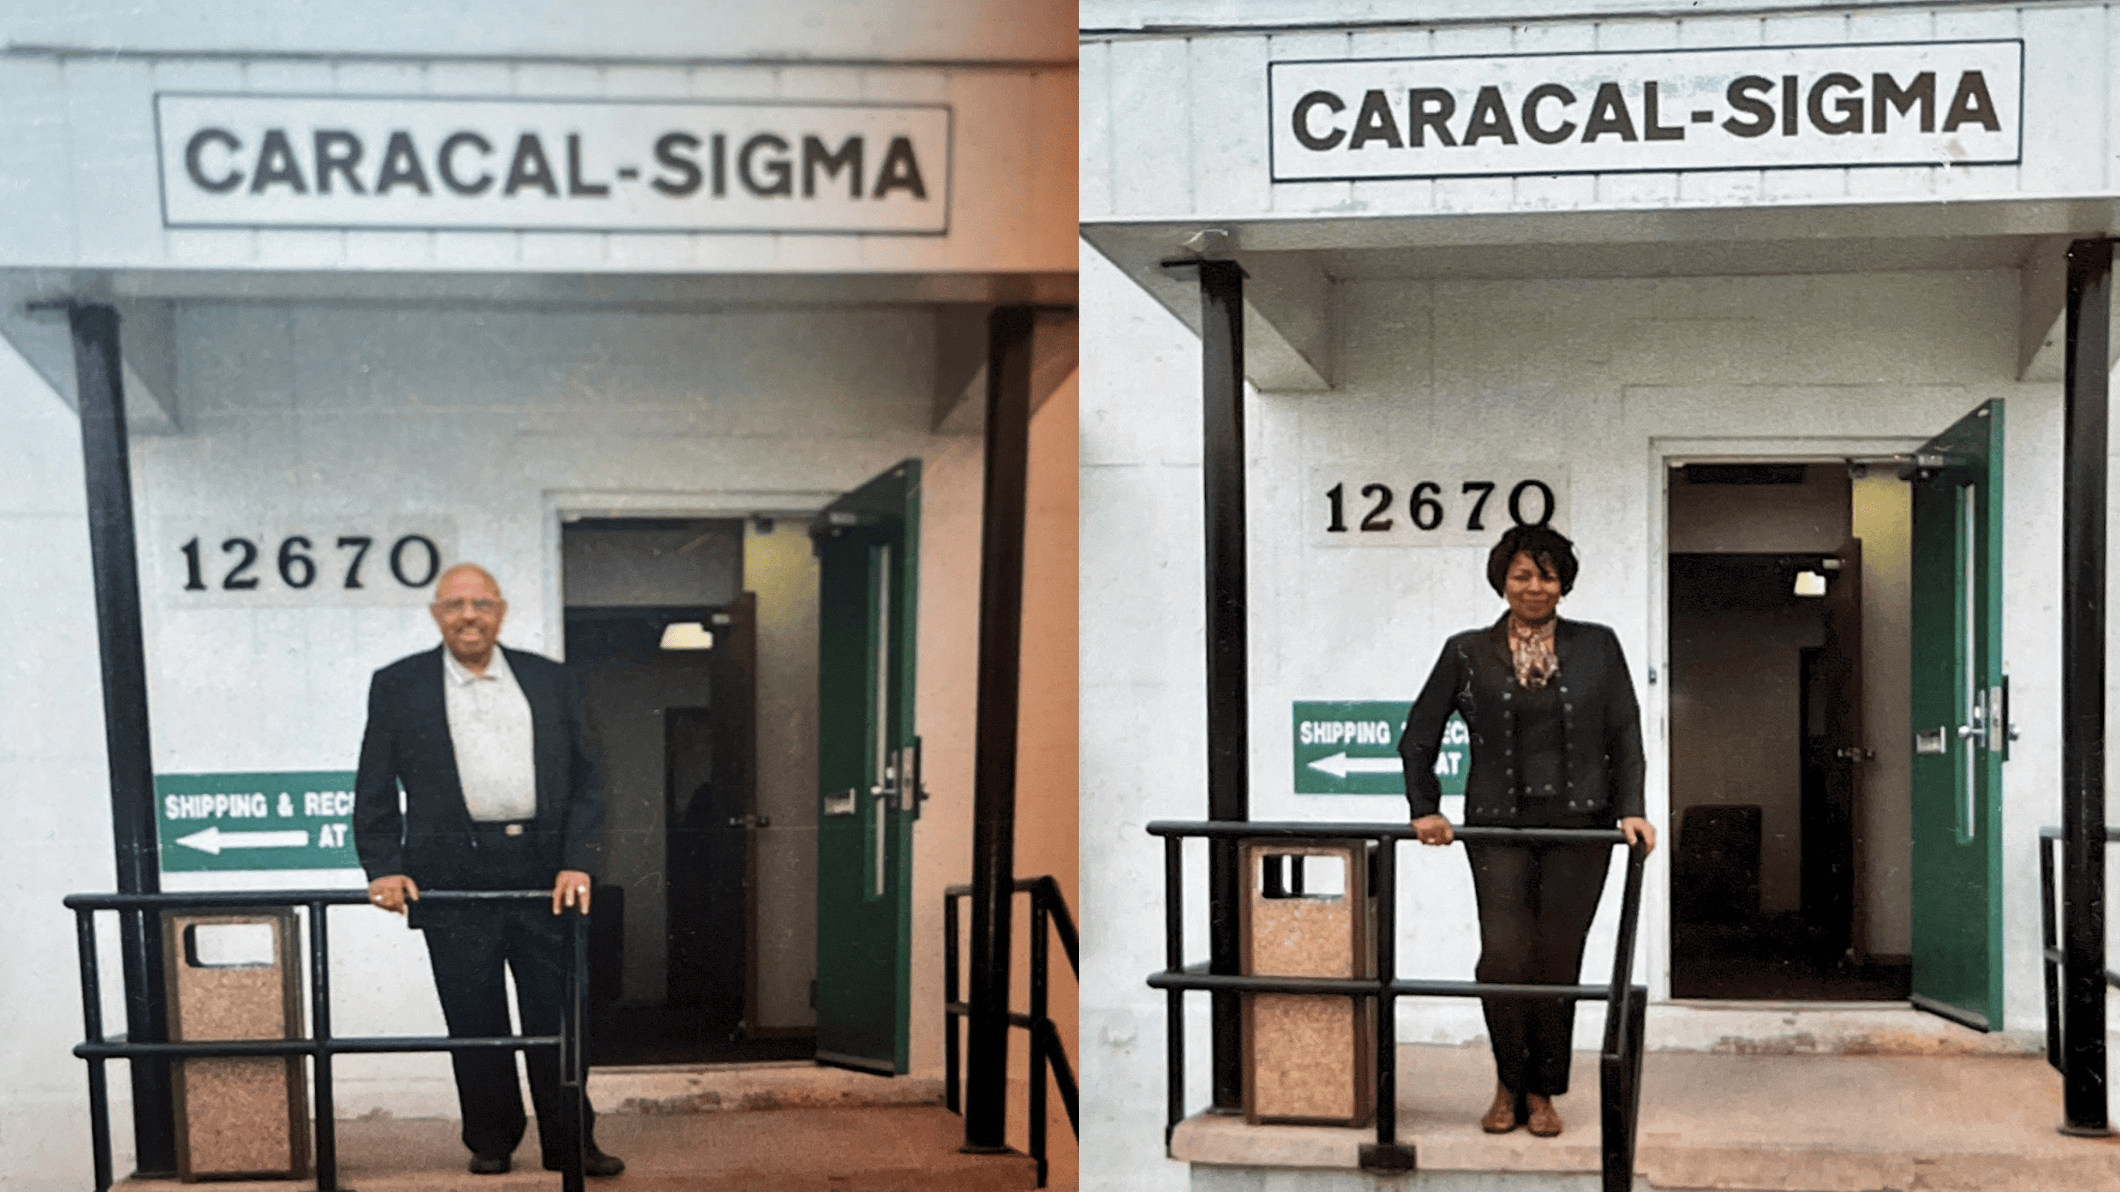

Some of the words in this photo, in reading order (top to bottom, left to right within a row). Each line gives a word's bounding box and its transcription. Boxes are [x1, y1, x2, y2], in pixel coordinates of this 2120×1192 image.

[1291, 70, 2001, 151] CARACAL-SIGMA
[184, 126, 928, 199] CARACAL-SIGMA
[1326, 479, 1555, 532] 12670
[180, 533, 441, 591] 12670
[1300, 720, 1391, 745] SHIPPING
[1433, 751, 1462, 776] AT
[164, 792, 268, 820] SHIPPING
[277, 792, 294, 818] &
[318, 823, 348, 848] AT
